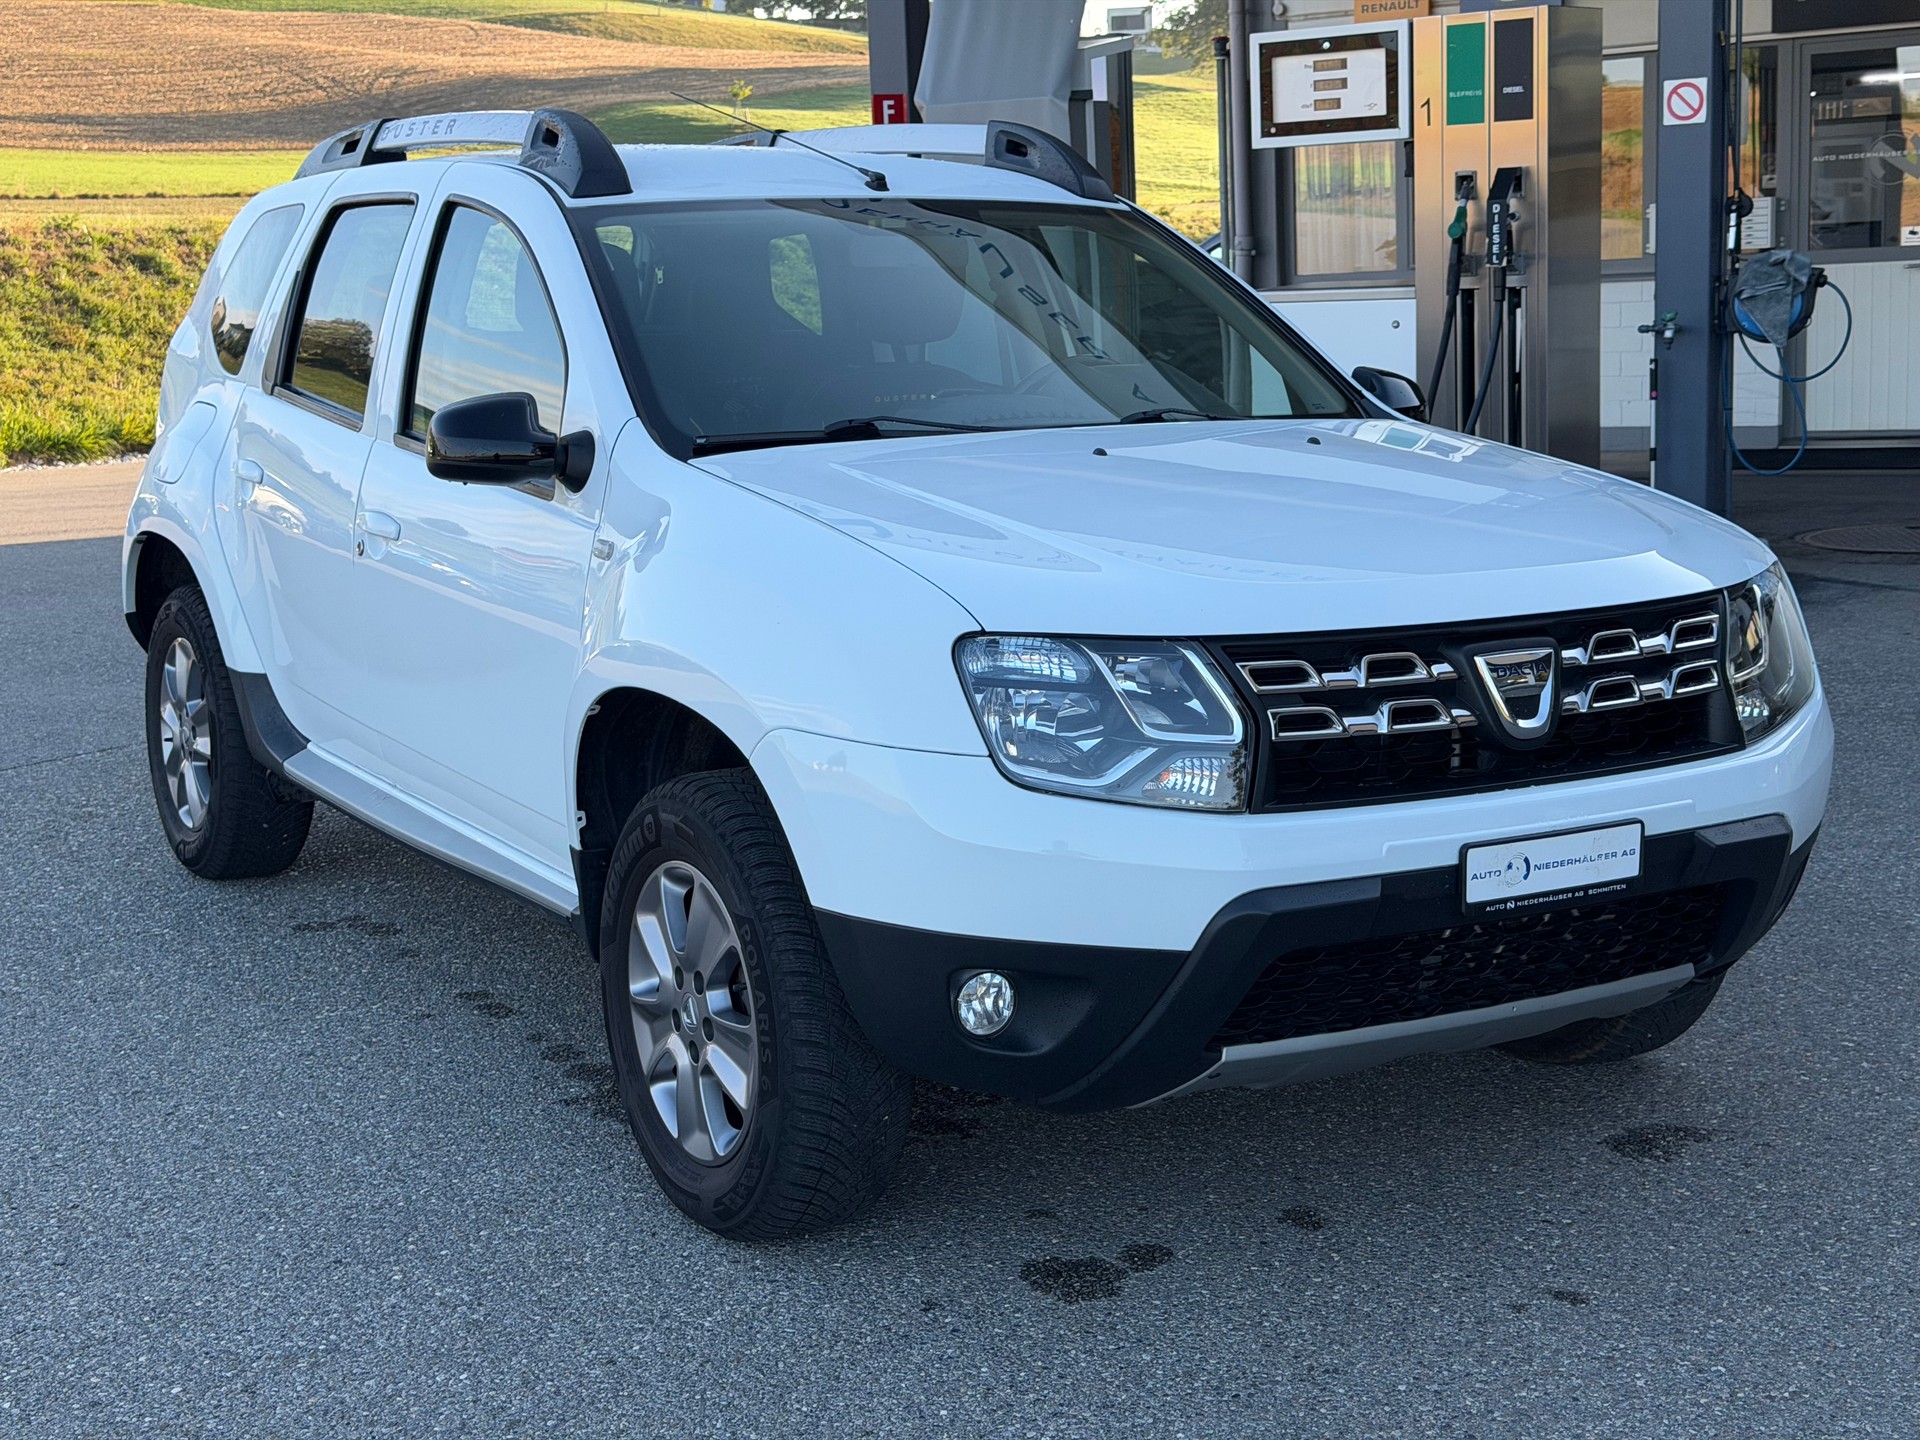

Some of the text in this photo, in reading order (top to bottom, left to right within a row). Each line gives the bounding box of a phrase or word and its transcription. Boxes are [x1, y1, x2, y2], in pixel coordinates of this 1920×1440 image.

[1361, 0, 1420, 14] RENAULT
[1502, 86, 1525, 94] DIESEL
[882, 99, 896, 125] F
[1420, 97, 1431, 127] 1
[1812, 153, 1837, 162] AUTO
[1492, 204, 1501, 263] DIESEL
[1496, 662, 1547, 679] DACIA
[1470, 848, 1637, 881] AUTO NIEDERHÄUSER AG
[1485, 903, 1505, 912] AUTO
[1516, 893, 1573, 906] NIEDERHÄUSER
[1574, 890, 1585, 898] AG
[1588, 883, 1627, 895] SCHMITTEN
[739, 923, 773, 1064] POLARIS
